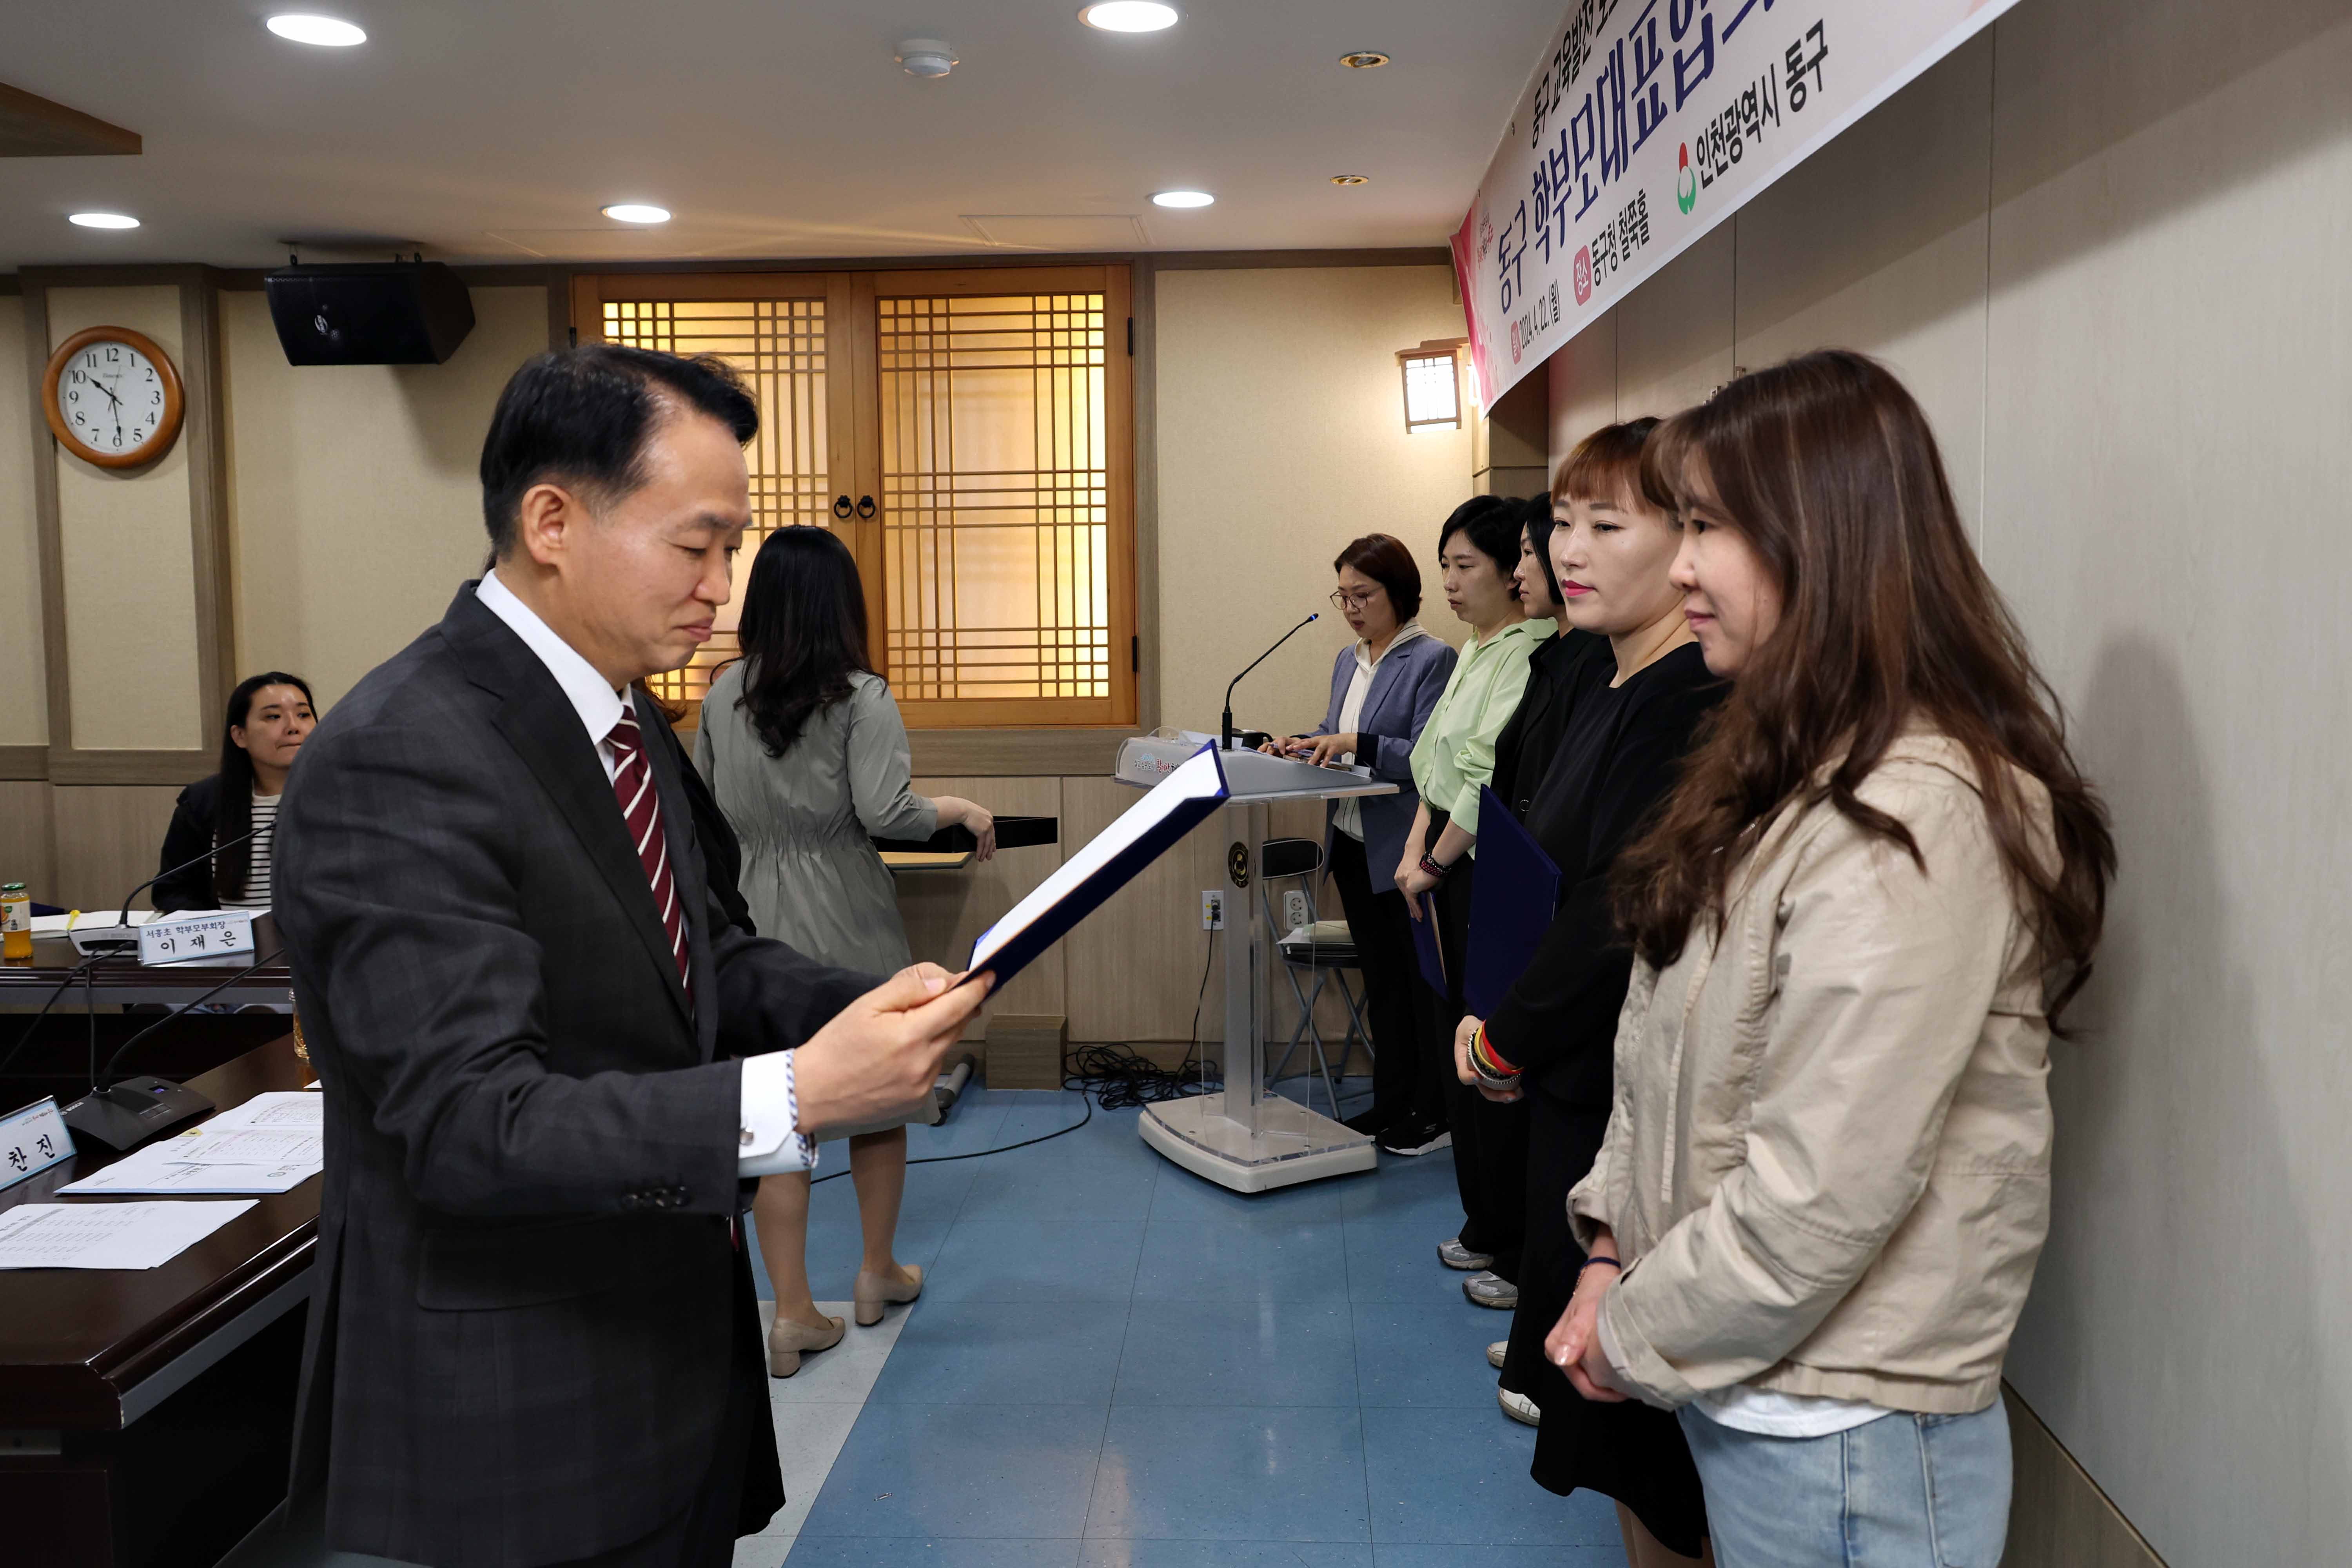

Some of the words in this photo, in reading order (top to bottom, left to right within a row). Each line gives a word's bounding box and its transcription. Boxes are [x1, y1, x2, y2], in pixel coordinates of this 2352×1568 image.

[1532, 71, 1550, 149] 동구
[1696, 62, 1780, 190] 인천광역시
[1785, 18, 1828, 113] 동구
[1499, 200, 1527, 314] 동구
[1532, 0, 1775, 265] 학부모대표협
[1576, 257, 1589, 295] 장소
[1592, 219, 1618, 287] 동구청
[1619, 188, 1650, 262] 철쭉홀
[86, 354, 97, 368] 11
[105, 348, 119, 361] 12
[130, 353, 135, 367] 1
[72, 370, 86, 384] 10
[145, 368, 153, 382] 2
[69, 391, 79, 404] 9
[151, 391, 161, 405] 3
[75, 411, 85, 425] 8
[145, 412, 155, 425] 4
[91, 428, 100, 442] 7
[113, 432, 122, 447] 6
[133, 428, 142, 442] 5
[146, 928, 172, 938] 서흥초
[176, 921, 226, 935] 학부모부회장
